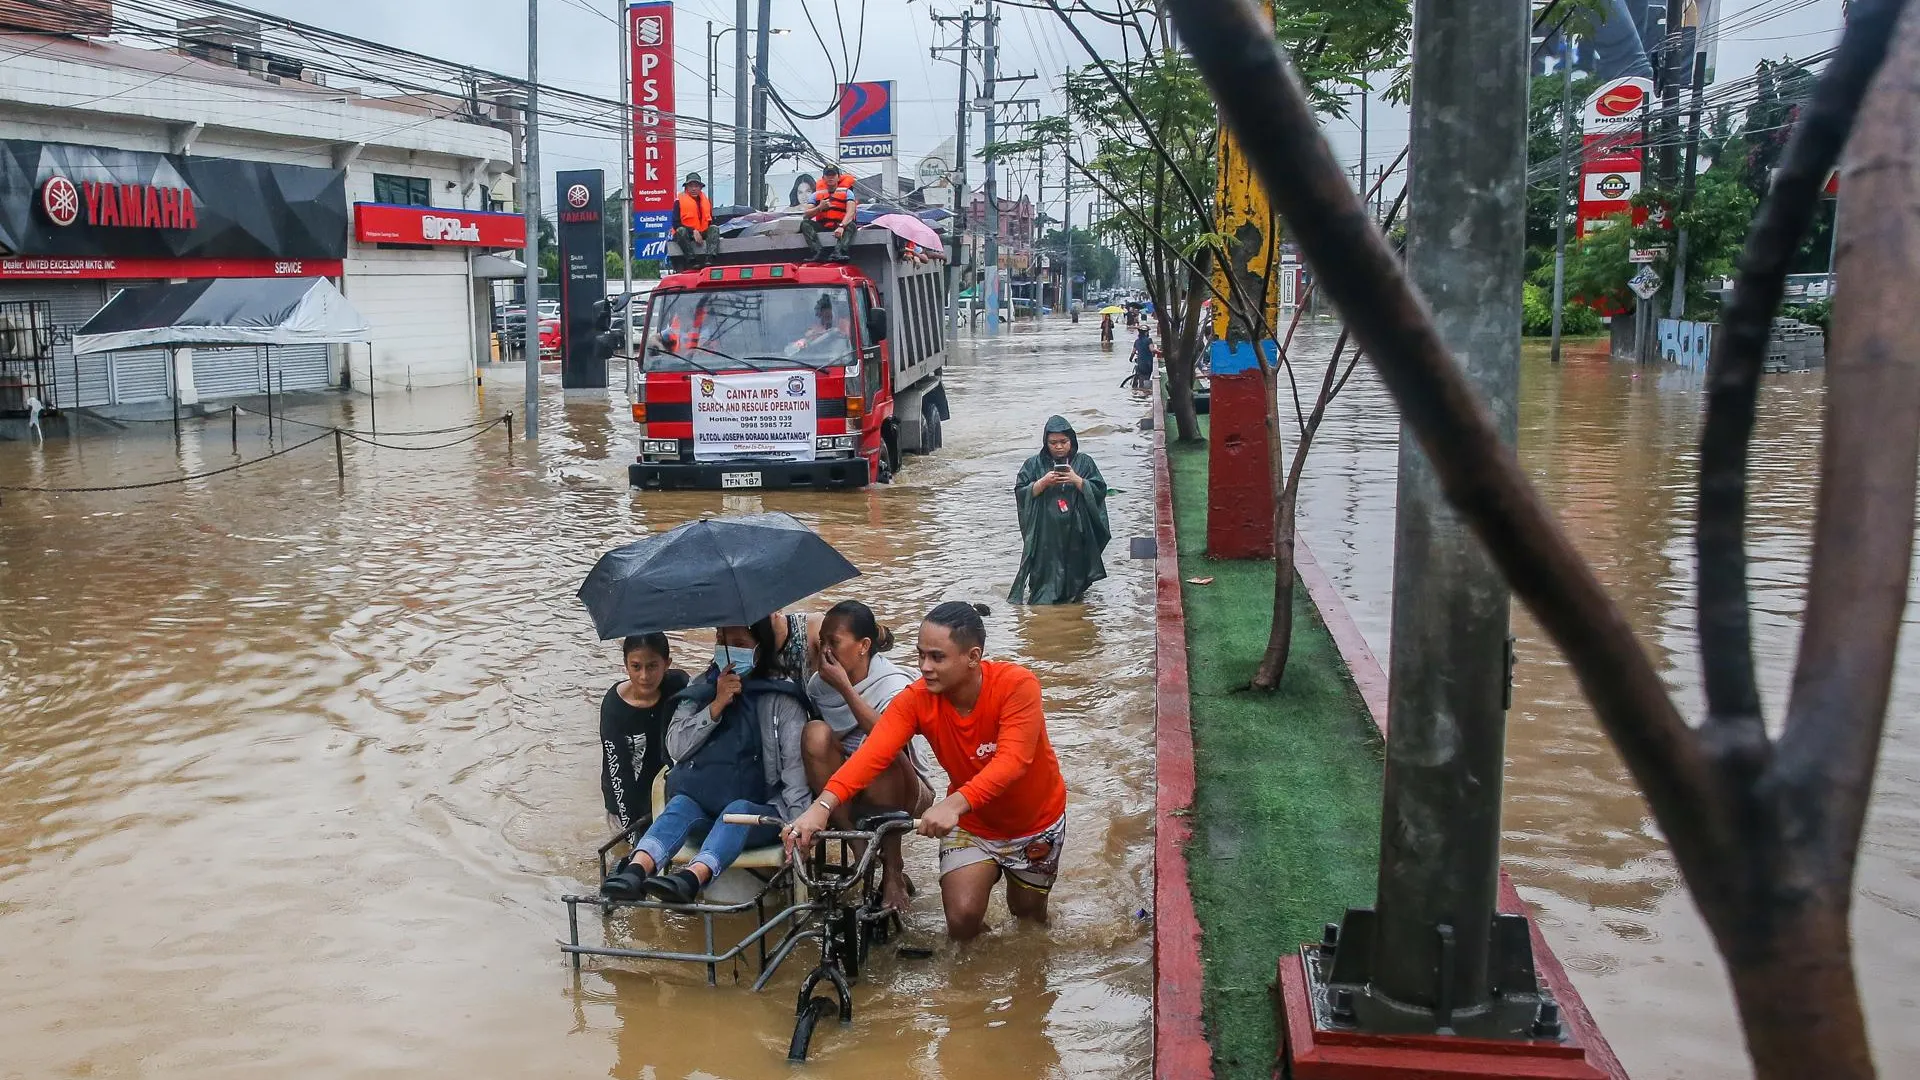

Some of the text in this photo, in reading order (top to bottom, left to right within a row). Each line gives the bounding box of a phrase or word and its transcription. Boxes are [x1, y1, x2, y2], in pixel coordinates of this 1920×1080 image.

[840, 144, 891, 156] PETRON
[83, 181, 197, 229] YAMAHA
[560, 212, 599, 222] YAMAHA
[436, 217, 480, 242] PSBank
[642, 240, 667, 257] ATM
[26, 260, 49, 269] UNITED
[50, 260, 84, 269] EXCELSIOR
[274, 262, 302, 274] SERVICE
[726, 388, 779, 399] CAINTA MPS
[698, 400, 810, 412] SEARCH AND RESCUE OPERATION
[722, 433, 744, 441] JOSEPH
[770, 431, 810, 441] MACATANGAY
[744, 477, 759, 485] 187
